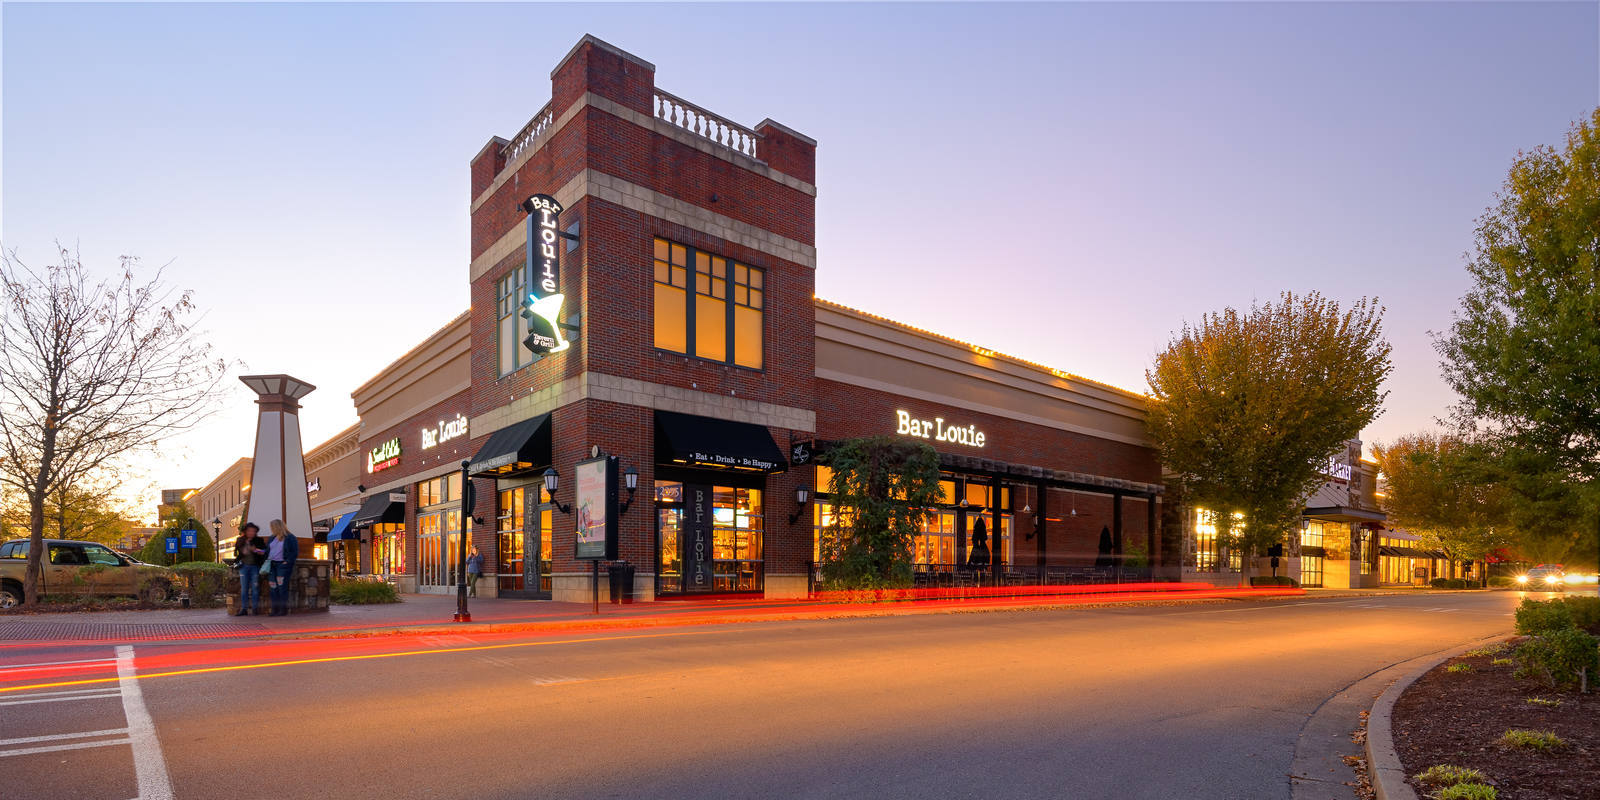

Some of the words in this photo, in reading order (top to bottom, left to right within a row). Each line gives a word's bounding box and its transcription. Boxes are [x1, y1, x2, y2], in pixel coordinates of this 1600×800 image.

[530, 196, 561, 213] Bar
[540, 208, 556, 293] Louie
[422, 428, 438, 450] Bar
[438, 413, 468, 444] Louie
[896, 409, 933, 439] Bar
[935, 417, 985, 448] Louie
[695, 452, 708, 461] Eat
[715, 454, 735, 464] Drink
[752, 459, 772, 469] Happy
[695, 490, 704, 523] Bar
[695, 530, 704, 584] Louie
